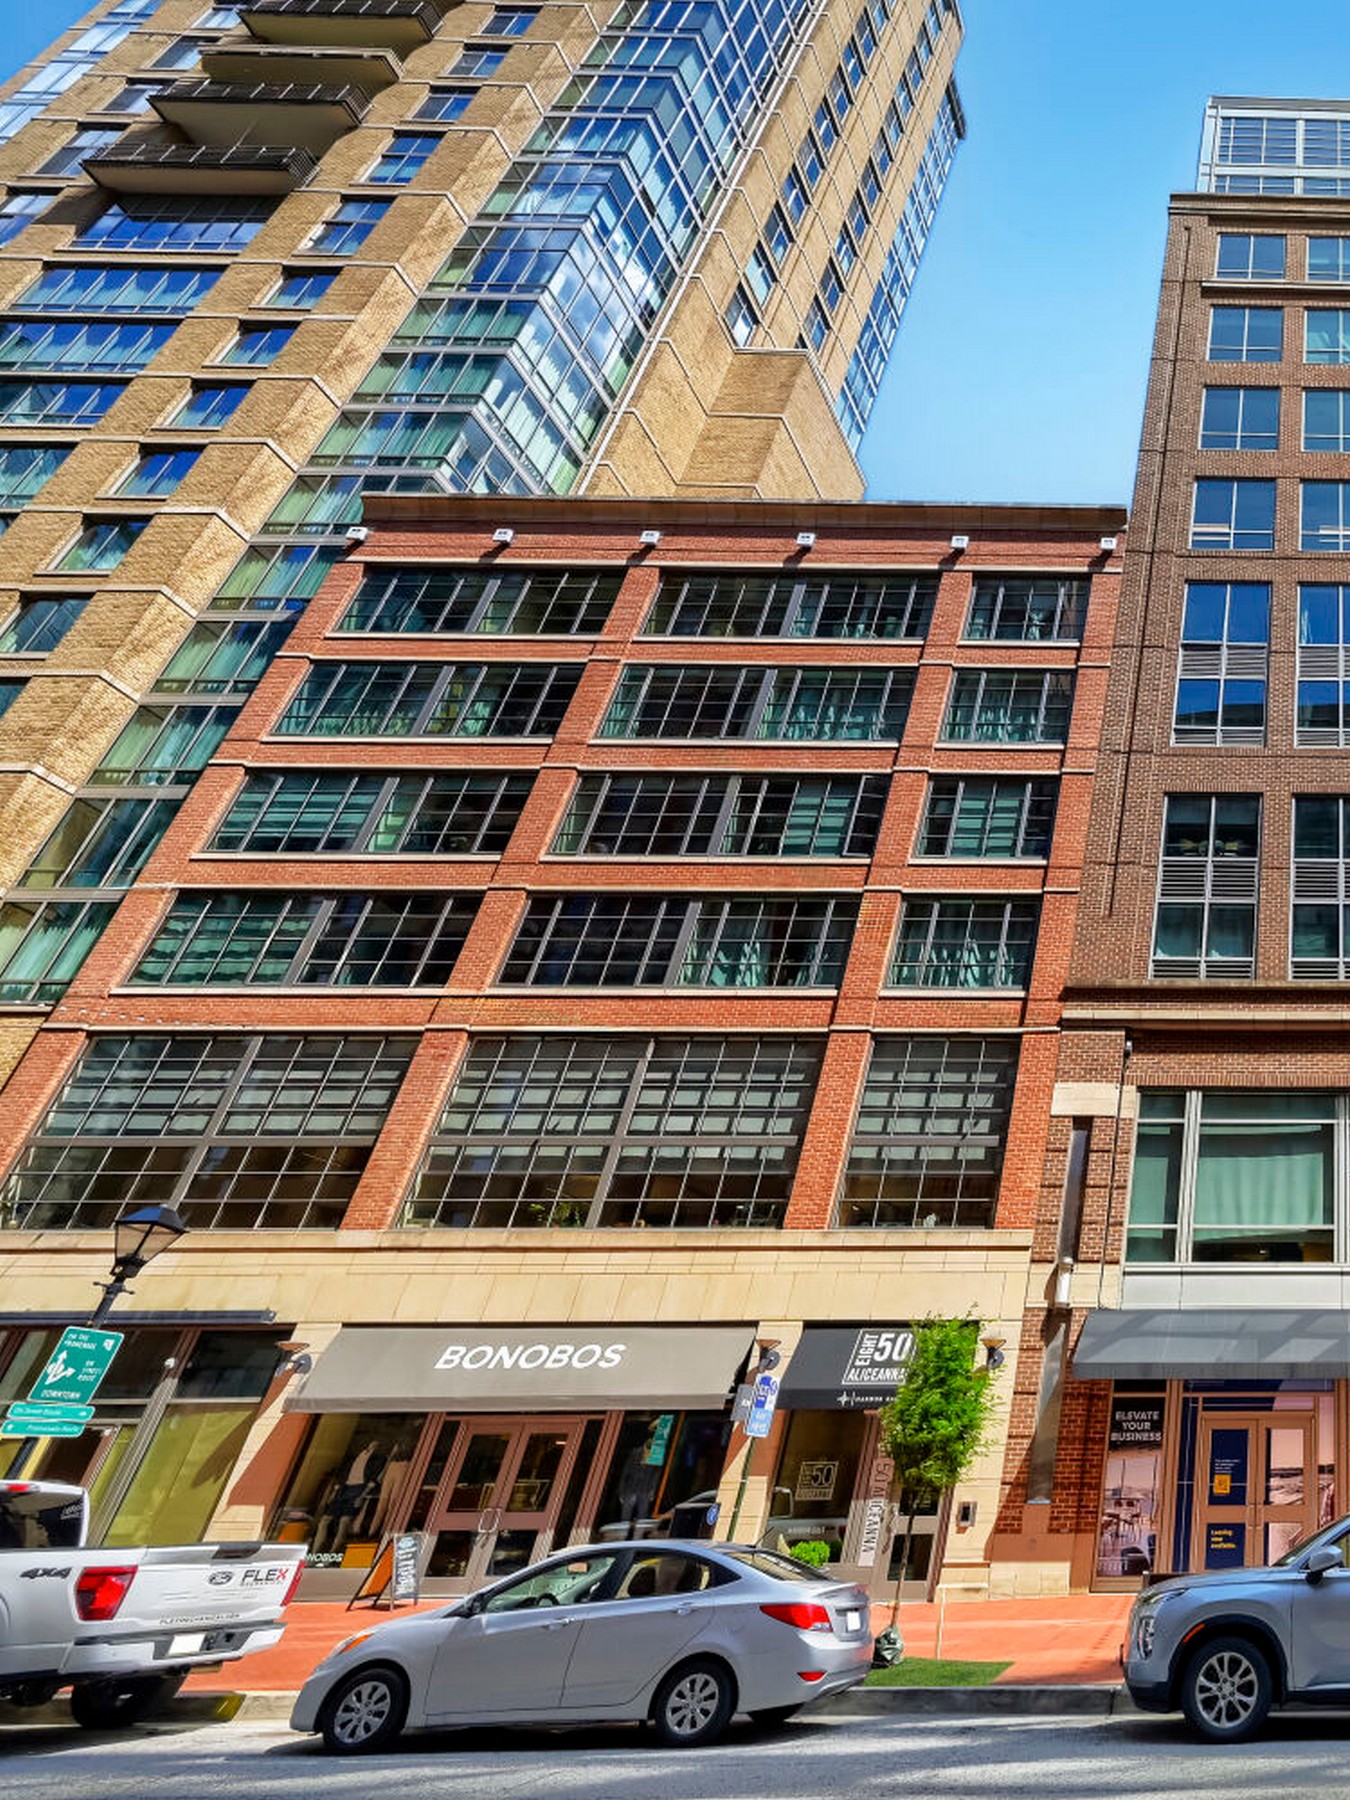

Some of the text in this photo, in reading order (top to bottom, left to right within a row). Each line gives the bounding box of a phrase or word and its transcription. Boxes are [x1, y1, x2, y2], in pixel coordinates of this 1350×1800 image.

[854, 1333, 879, 1366] EIGHT
[873, 1332, 914, 1362] 50
[433, 1344, 627, 1370] BONOBOS
[1115, 1410, 1160, 1421] ELEVATE
[1122, 1421, 1151, 1431] YOUR
[1110, 1431, 1162, 1441] BUSINESS
[811, 1464, 834, 1488] 50
[303, 1552, 344, 1563] NOBOS
[240, 1568, 289, 1582] FLEX
